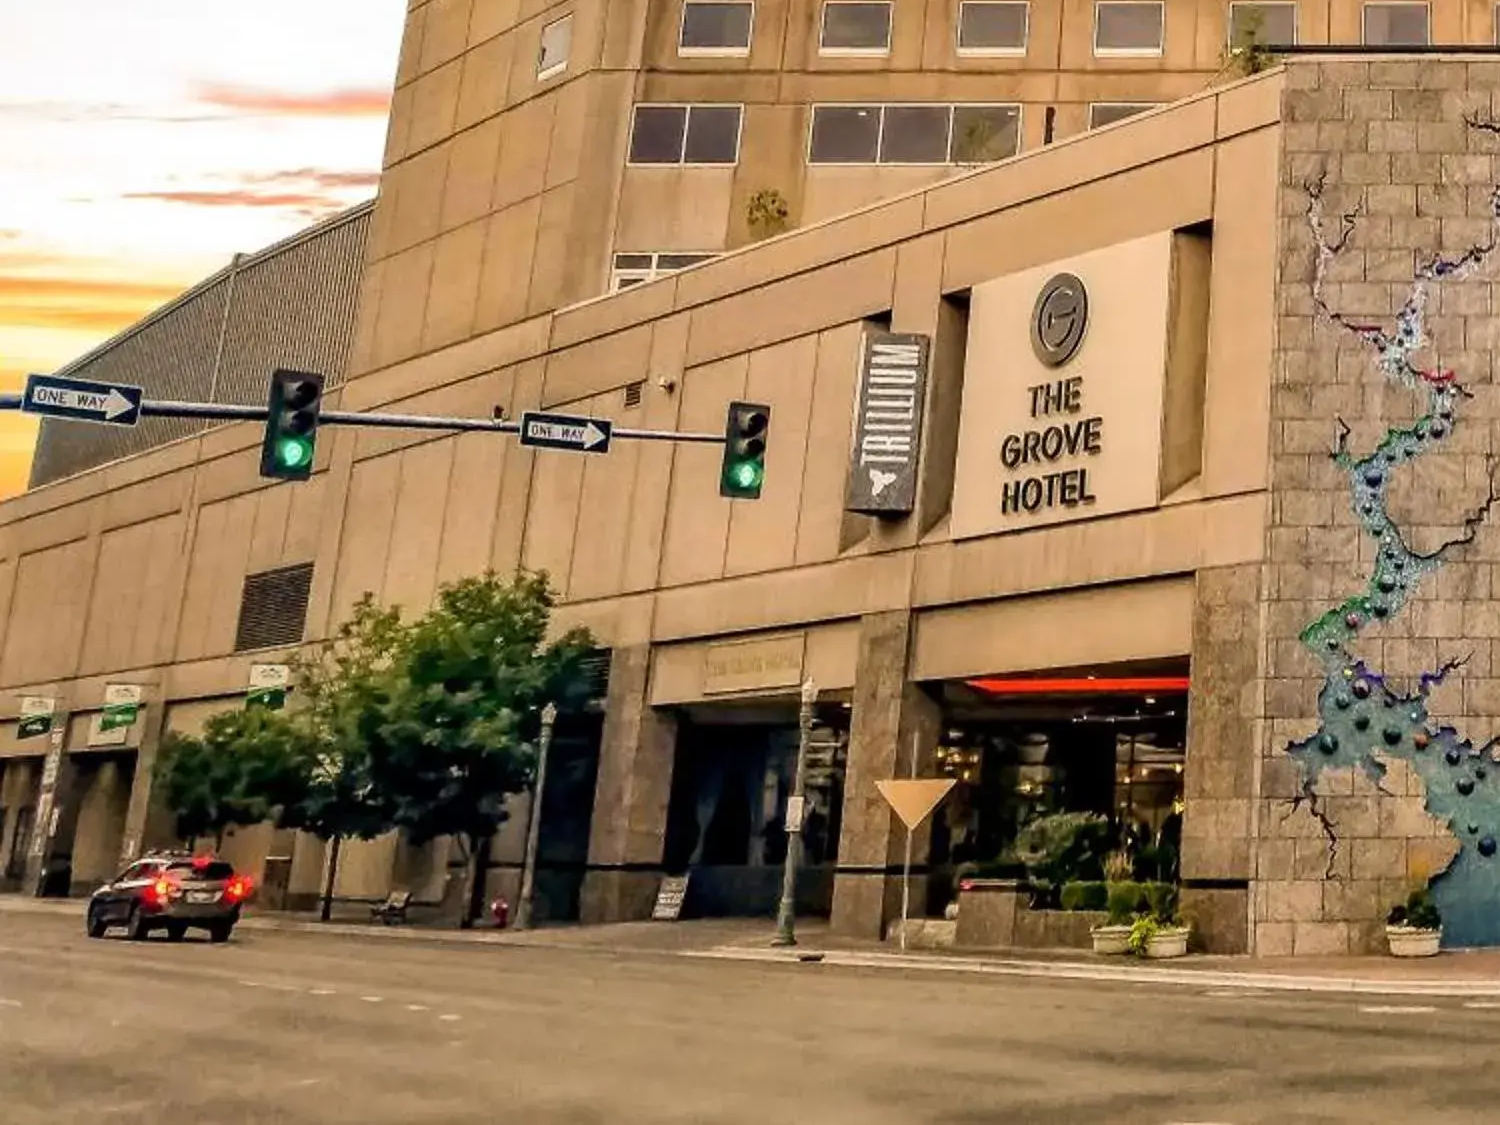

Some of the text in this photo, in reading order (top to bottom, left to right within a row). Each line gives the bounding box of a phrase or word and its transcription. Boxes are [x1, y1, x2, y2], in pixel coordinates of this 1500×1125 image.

[36, 388, 107, 409] ONE WAY
[860, 344, 920, 467] TRILLIUM
[1028, 376, 1082, 417] THE
[561, 426, 584, 440] WAY
[1000, 416, 1102, 468] GROVE
[1001, 468, 1096, 515] HOTEL
